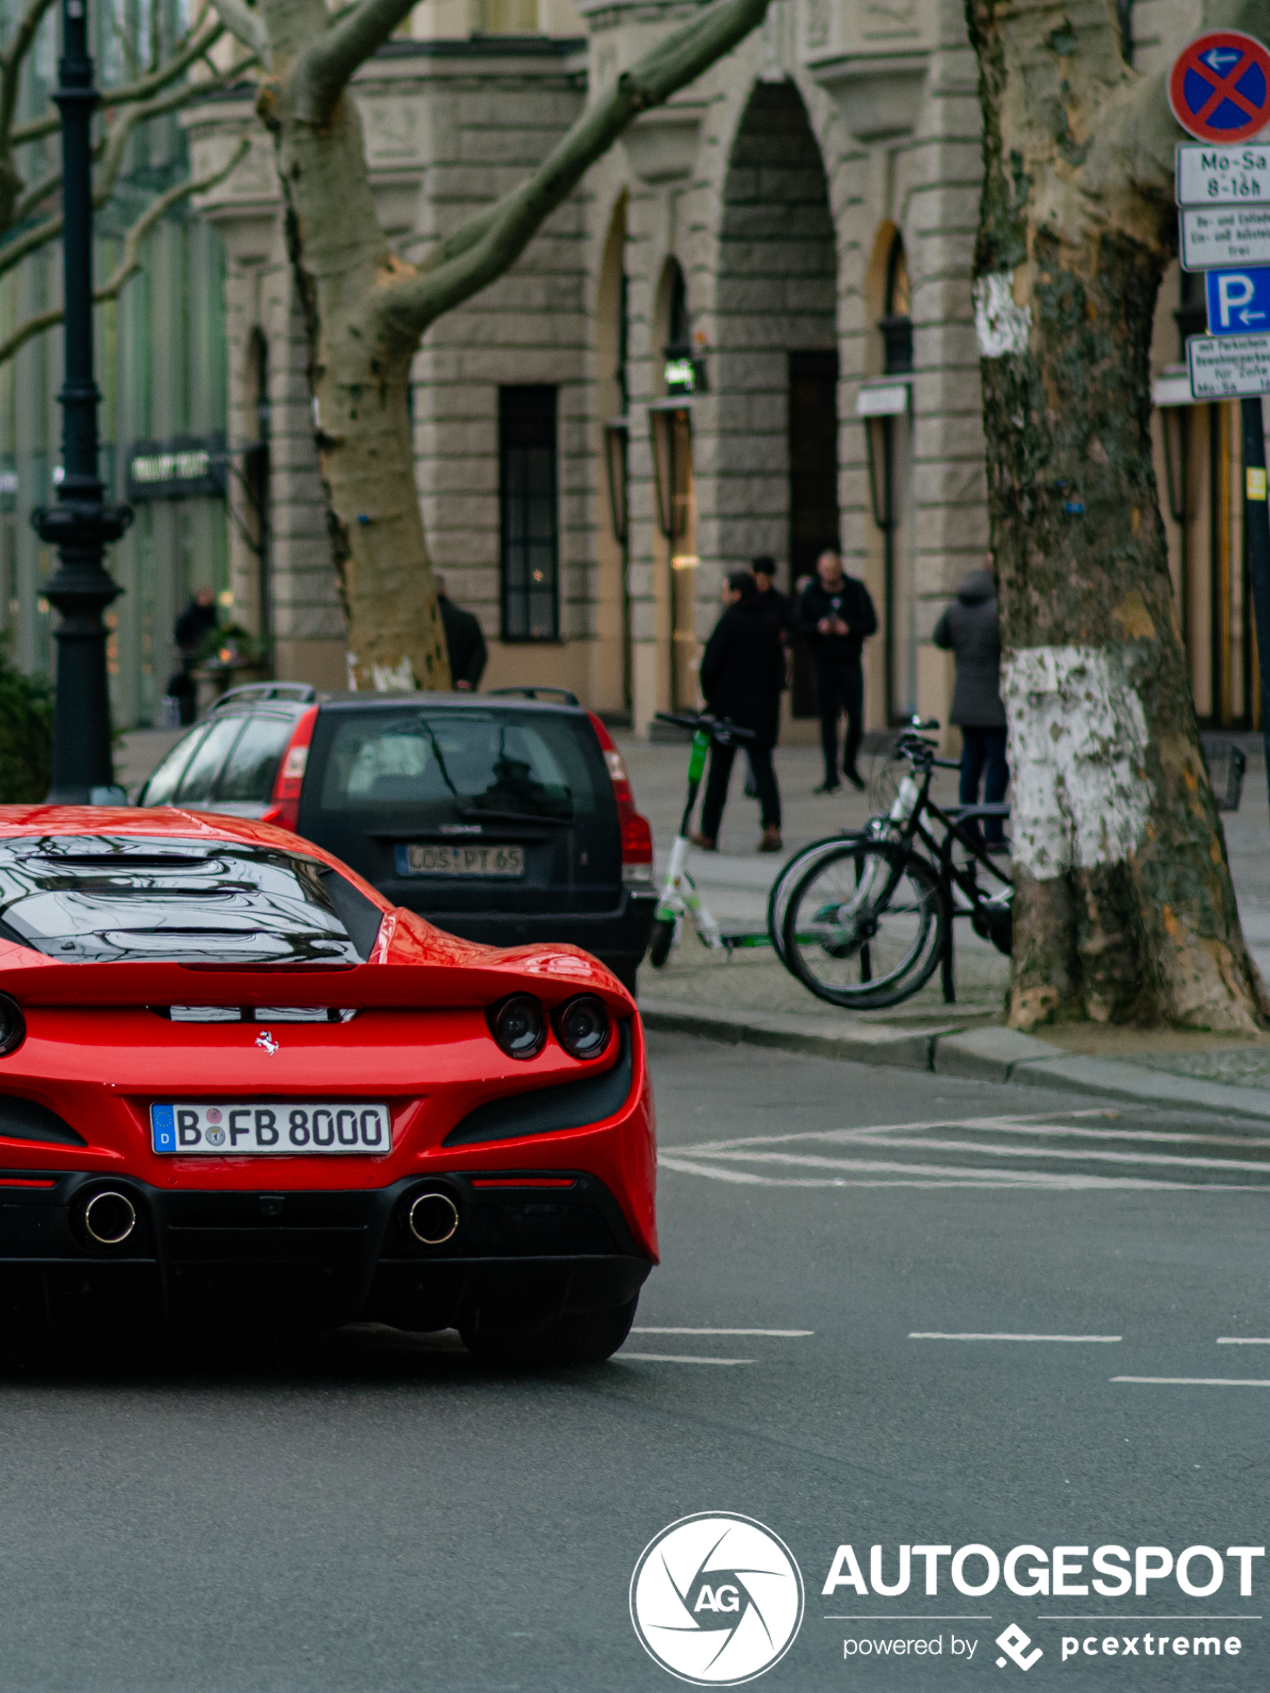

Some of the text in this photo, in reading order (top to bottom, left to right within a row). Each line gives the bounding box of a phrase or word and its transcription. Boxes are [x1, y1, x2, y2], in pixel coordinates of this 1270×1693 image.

[1201, 151, 1267, 171] Mo-Sa
[1207, 177, 1261, 197] 8-16h
[1218, 274, 1255, 327] P
[409, 849, 450, 870] LOS
[160, 1108, 383, 1147] D B FB 8000
